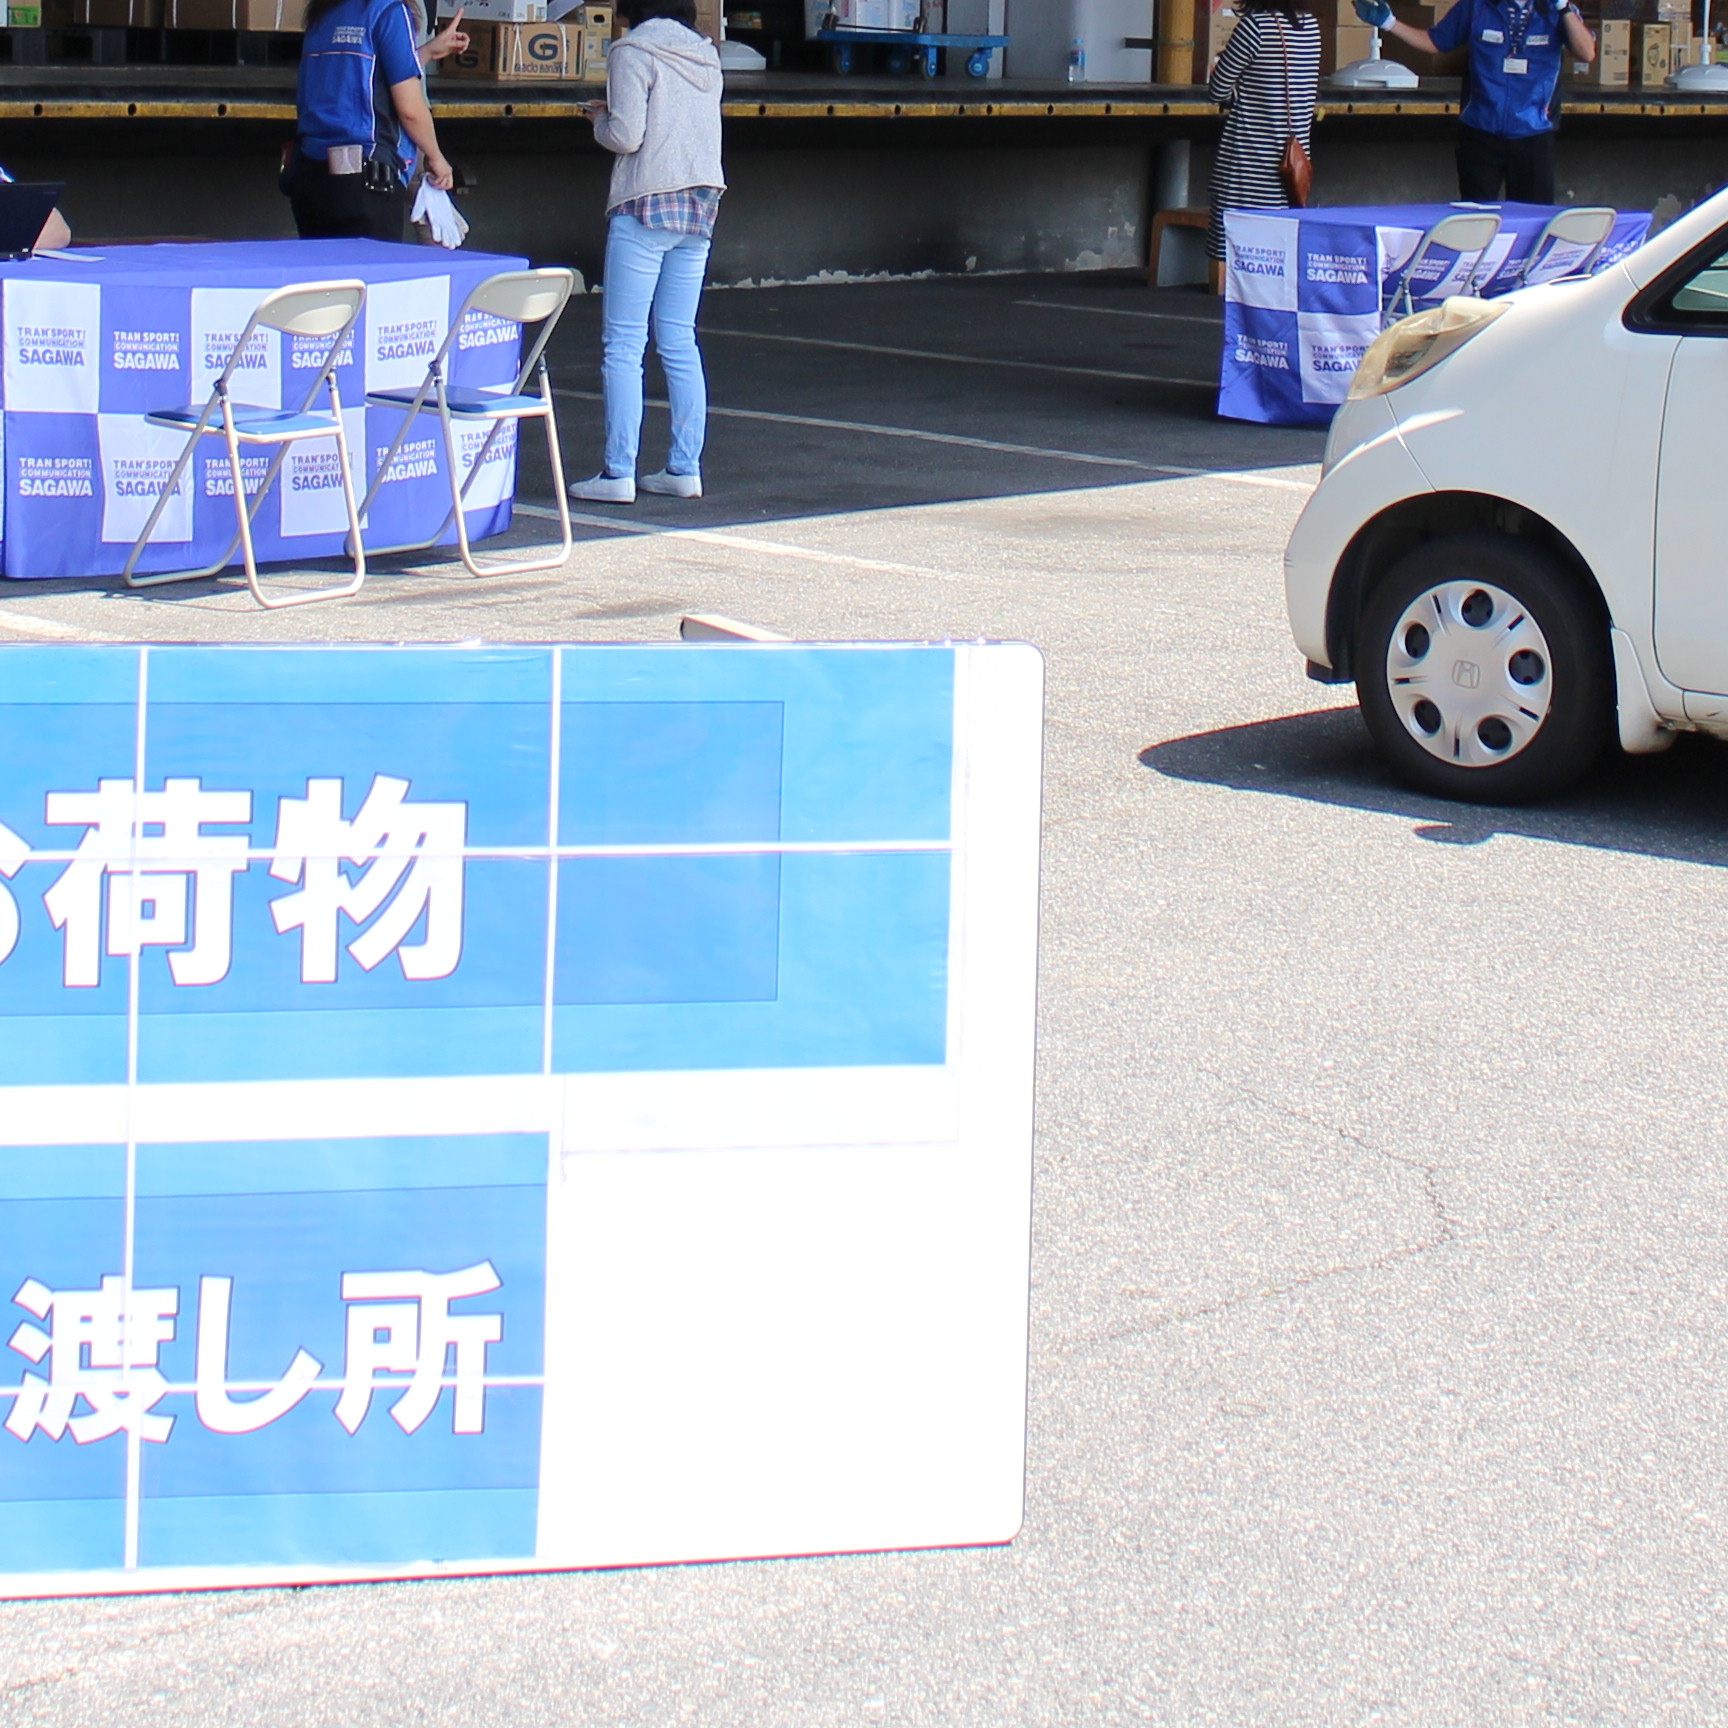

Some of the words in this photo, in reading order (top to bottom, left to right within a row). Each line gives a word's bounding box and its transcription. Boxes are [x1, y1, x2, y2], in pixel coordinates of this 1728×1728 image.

[1233, 260, 1285, 277] SAGAWA
[1306, 269, 1368, 284] SAGAWA
[458, 324, 519, 351] SAGAWA
[19, 348, 85, 367] SAGAWA
[377, 339, 436, 361] SAGAWA
[1235, 349, 1289, 369] SAGAWA
[114, 352, 180, 370] SAGAWA
[378, 460, 438, 483] AGAWA
[19, 479, 93, 497] SAGAWA
[292, 473, 343, 491] SAGAW
